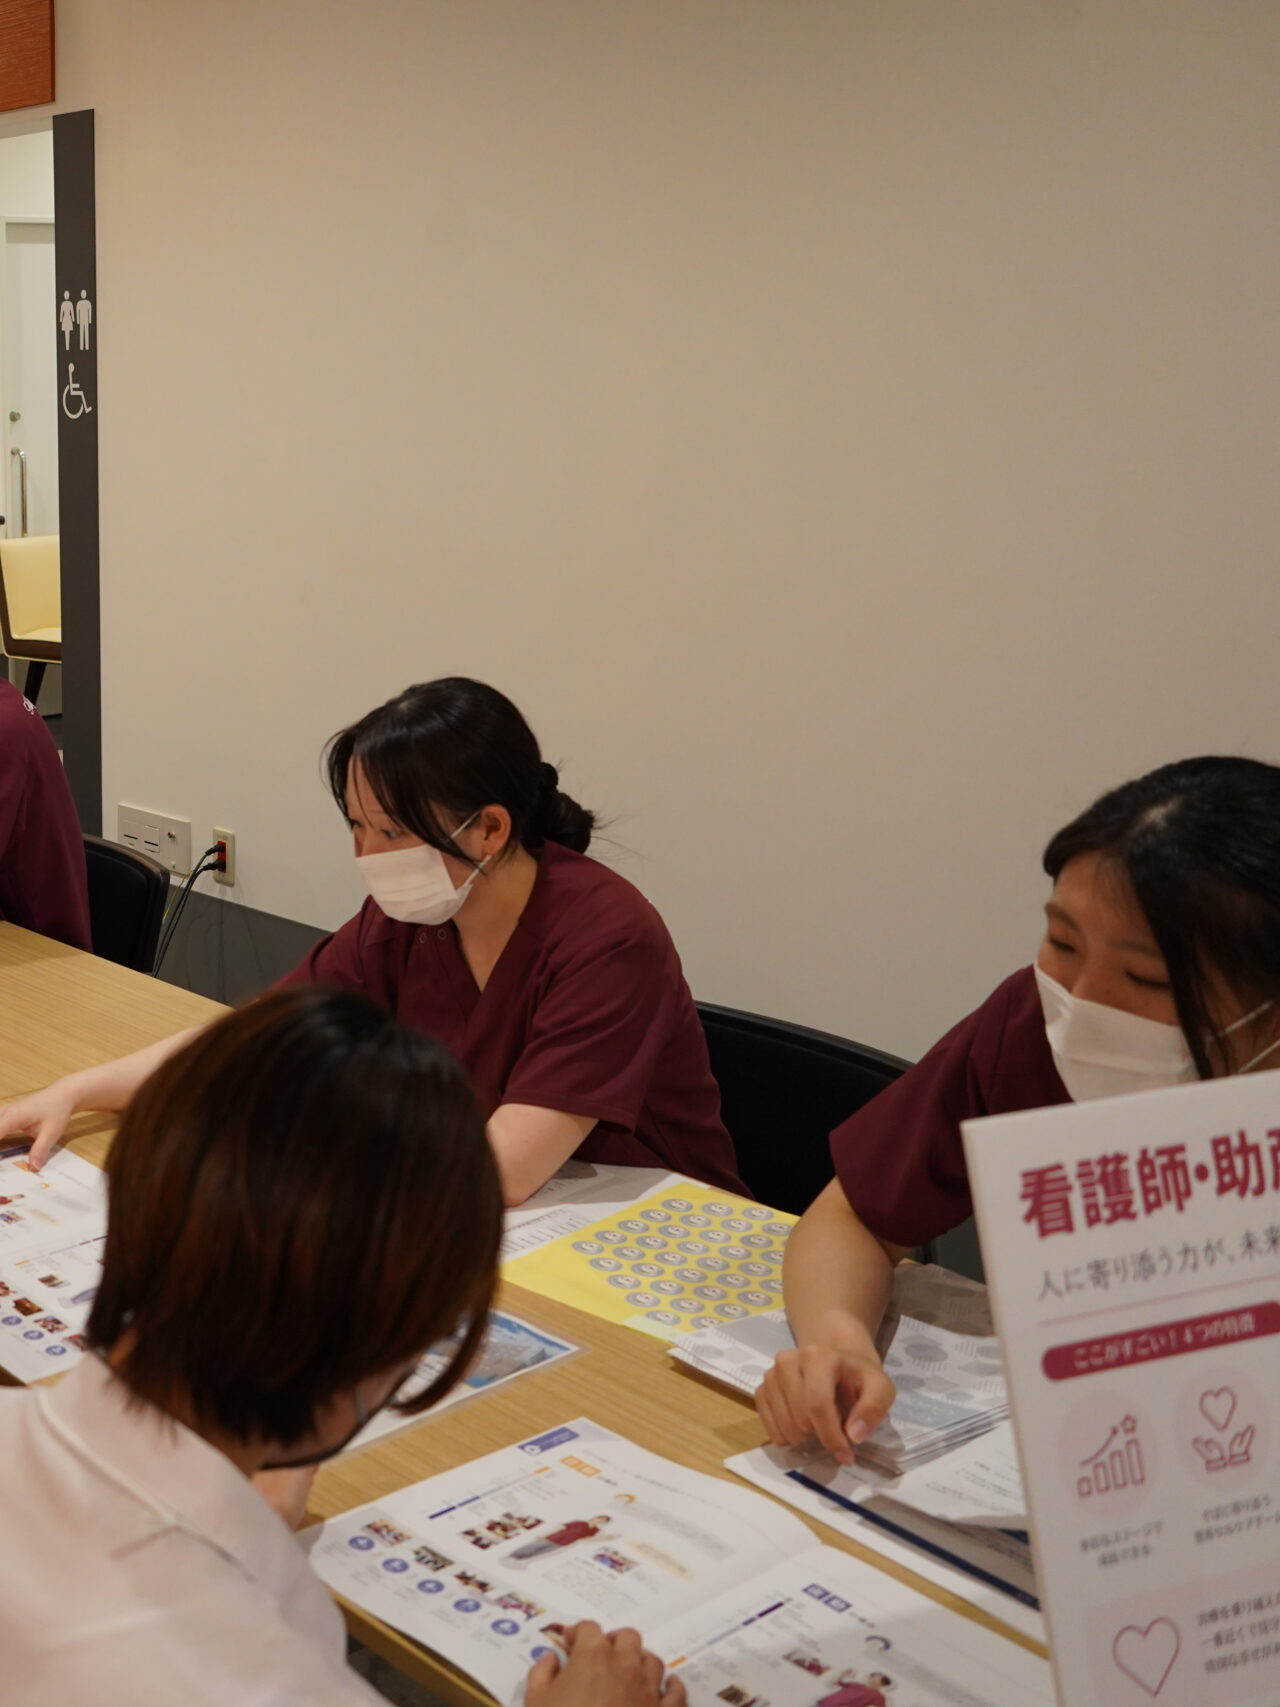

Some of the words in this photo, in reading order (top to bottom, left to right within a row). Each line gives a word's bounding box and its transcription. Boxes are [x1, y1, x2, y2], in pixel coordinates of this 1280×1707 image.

[1019, 1128, 1280, 1239] 看護師・助
